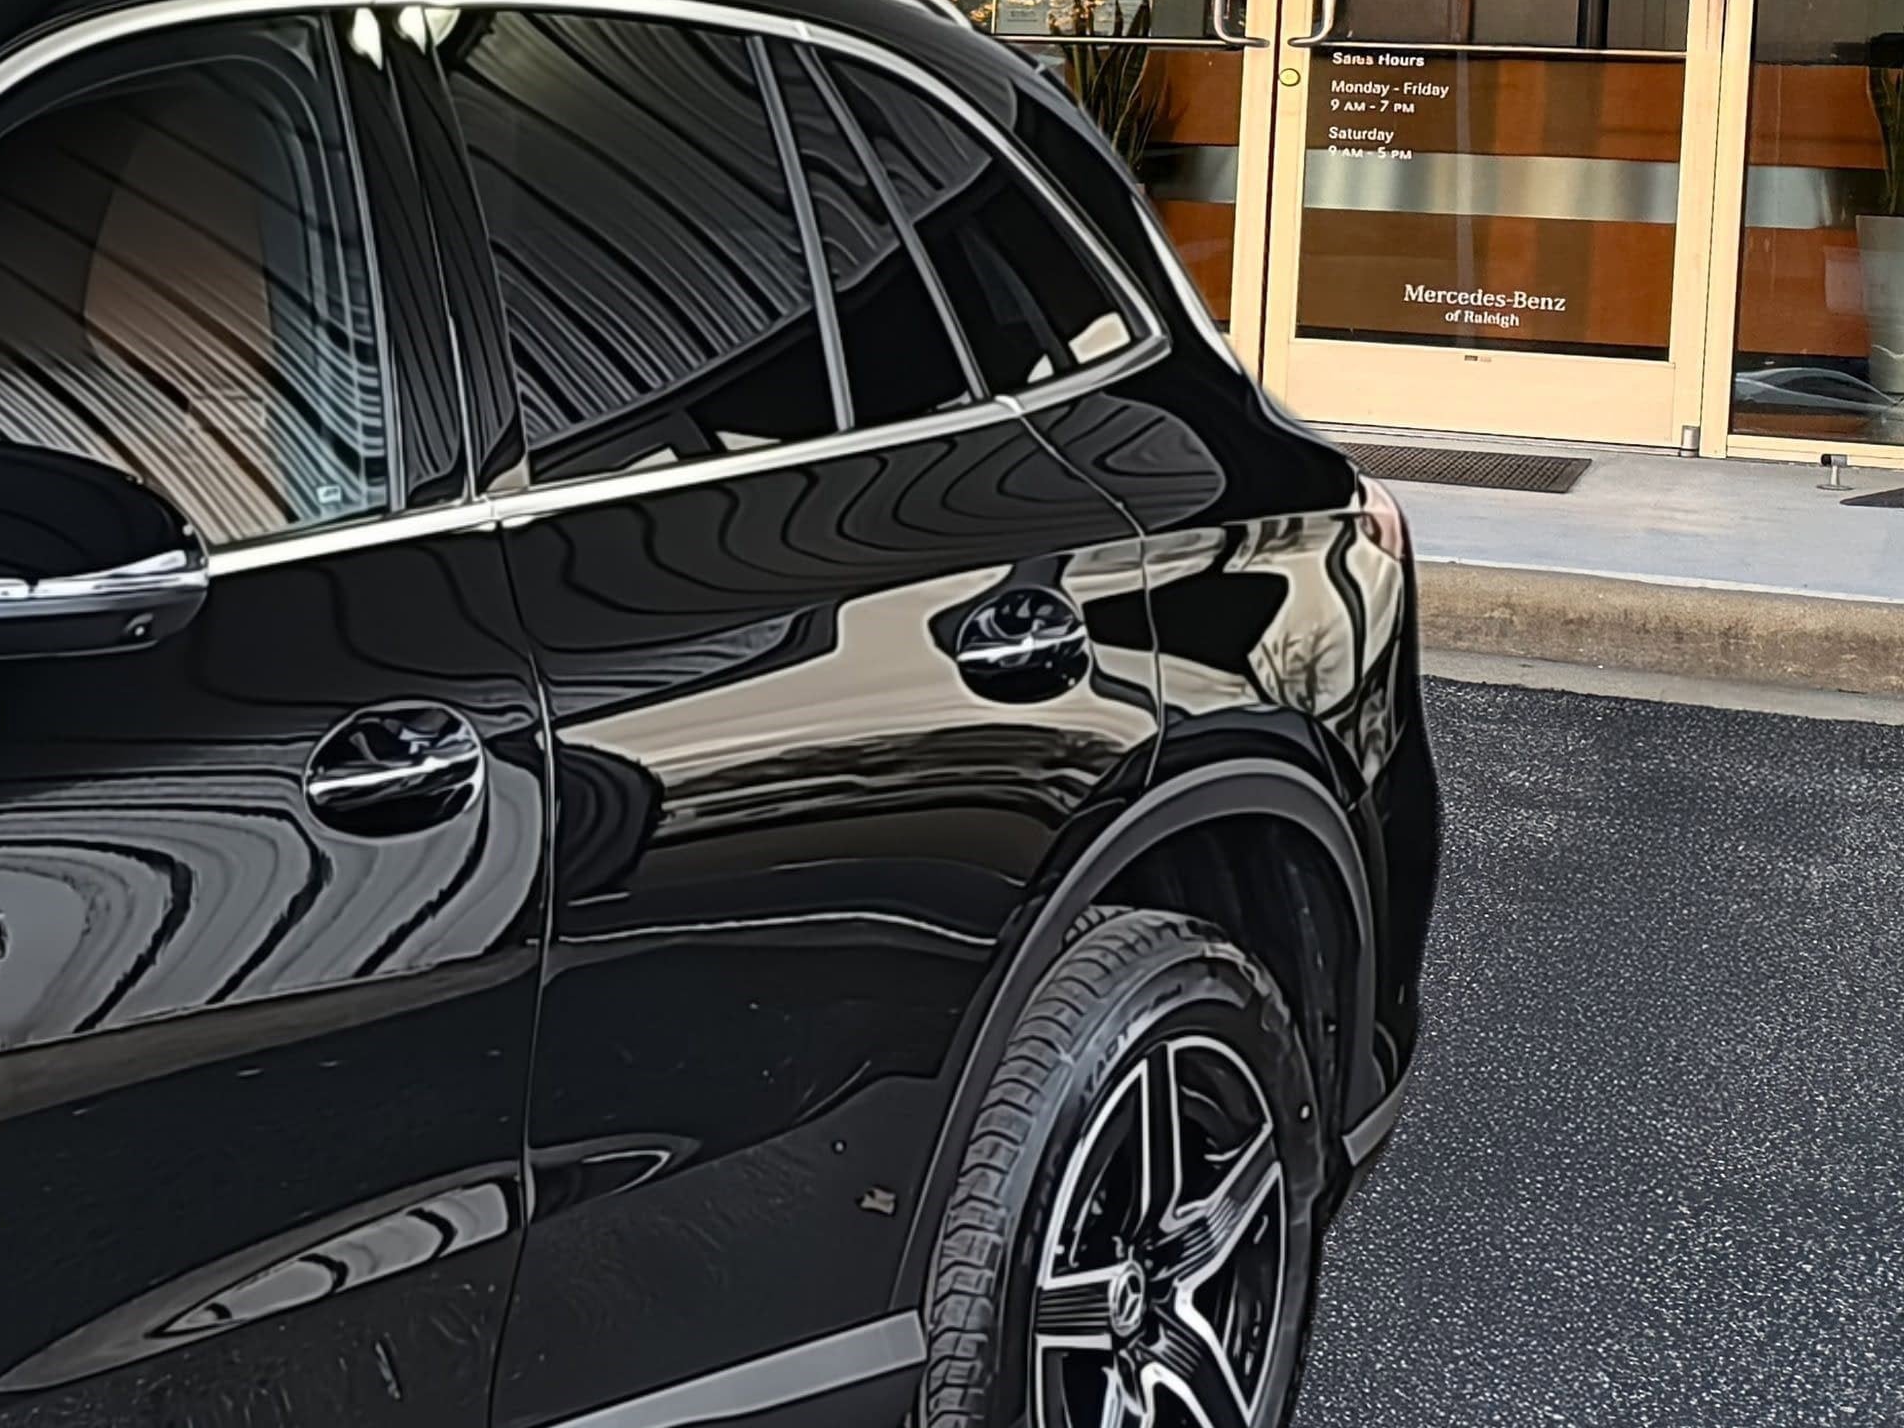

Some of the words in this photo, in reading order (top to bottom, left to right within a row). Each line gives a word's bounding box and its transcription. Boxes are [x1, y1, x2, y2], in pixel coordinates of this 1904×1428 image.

[1378, 53, 1425, 67] Hours
[1332, 79, 1390, 97] Monday
[1403, 82, 1450, 98] Friday
[1330, 98, 1340, 111] 9
[1343, 101, 1366, 112] AM
[1379, 100, 1389, 112] 7
[1393, 103, 1415, 114] PM
[1328, 126, 1394, 144] Saturday
[1327, 145, 1338, 157] 9
[1342, 147, 1364, 158] AM
[1377, 147, 1387, 158] 5
[1391, 149, 1412, 160] PM
[1403, 283, 1566, 312] Mercedes-Benz
[1445, 310, 1461, 322] of
[1464, 310, 1521, 329] Raleigh
